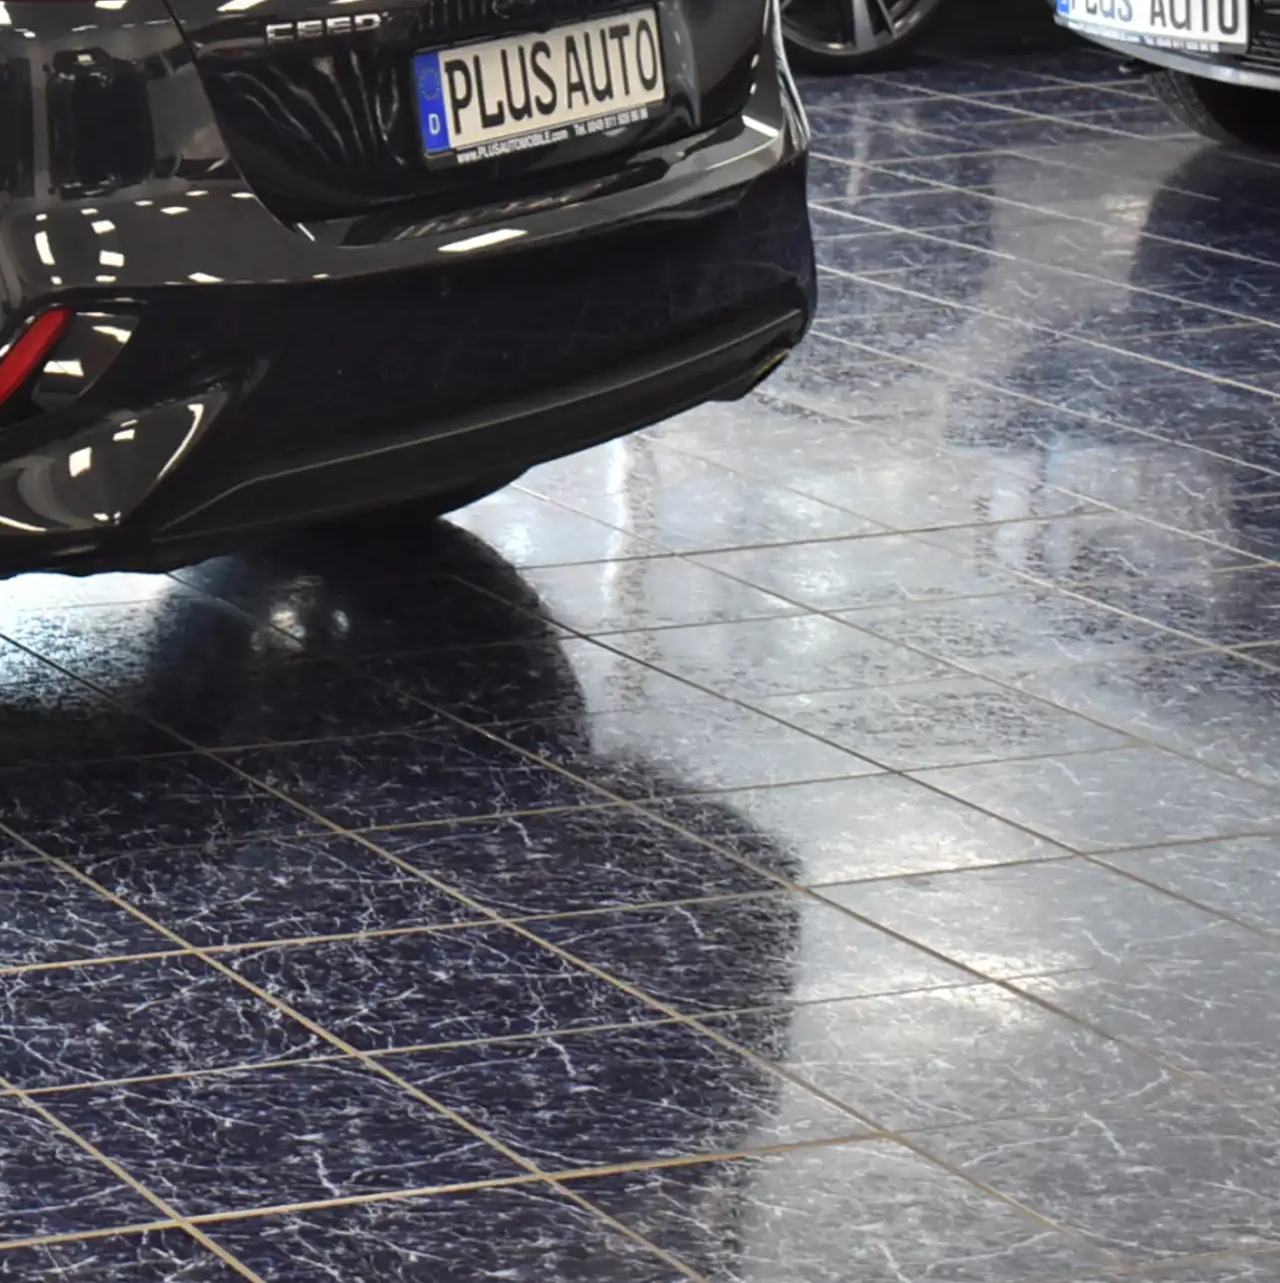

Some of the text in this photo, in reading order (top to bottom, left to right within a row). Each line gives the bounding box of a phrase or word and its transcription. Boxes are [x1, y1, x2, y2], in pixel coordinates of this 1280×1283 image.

[444, 18, 657, 135] PLUS AUTO
[428, 113, 440, 135] D
